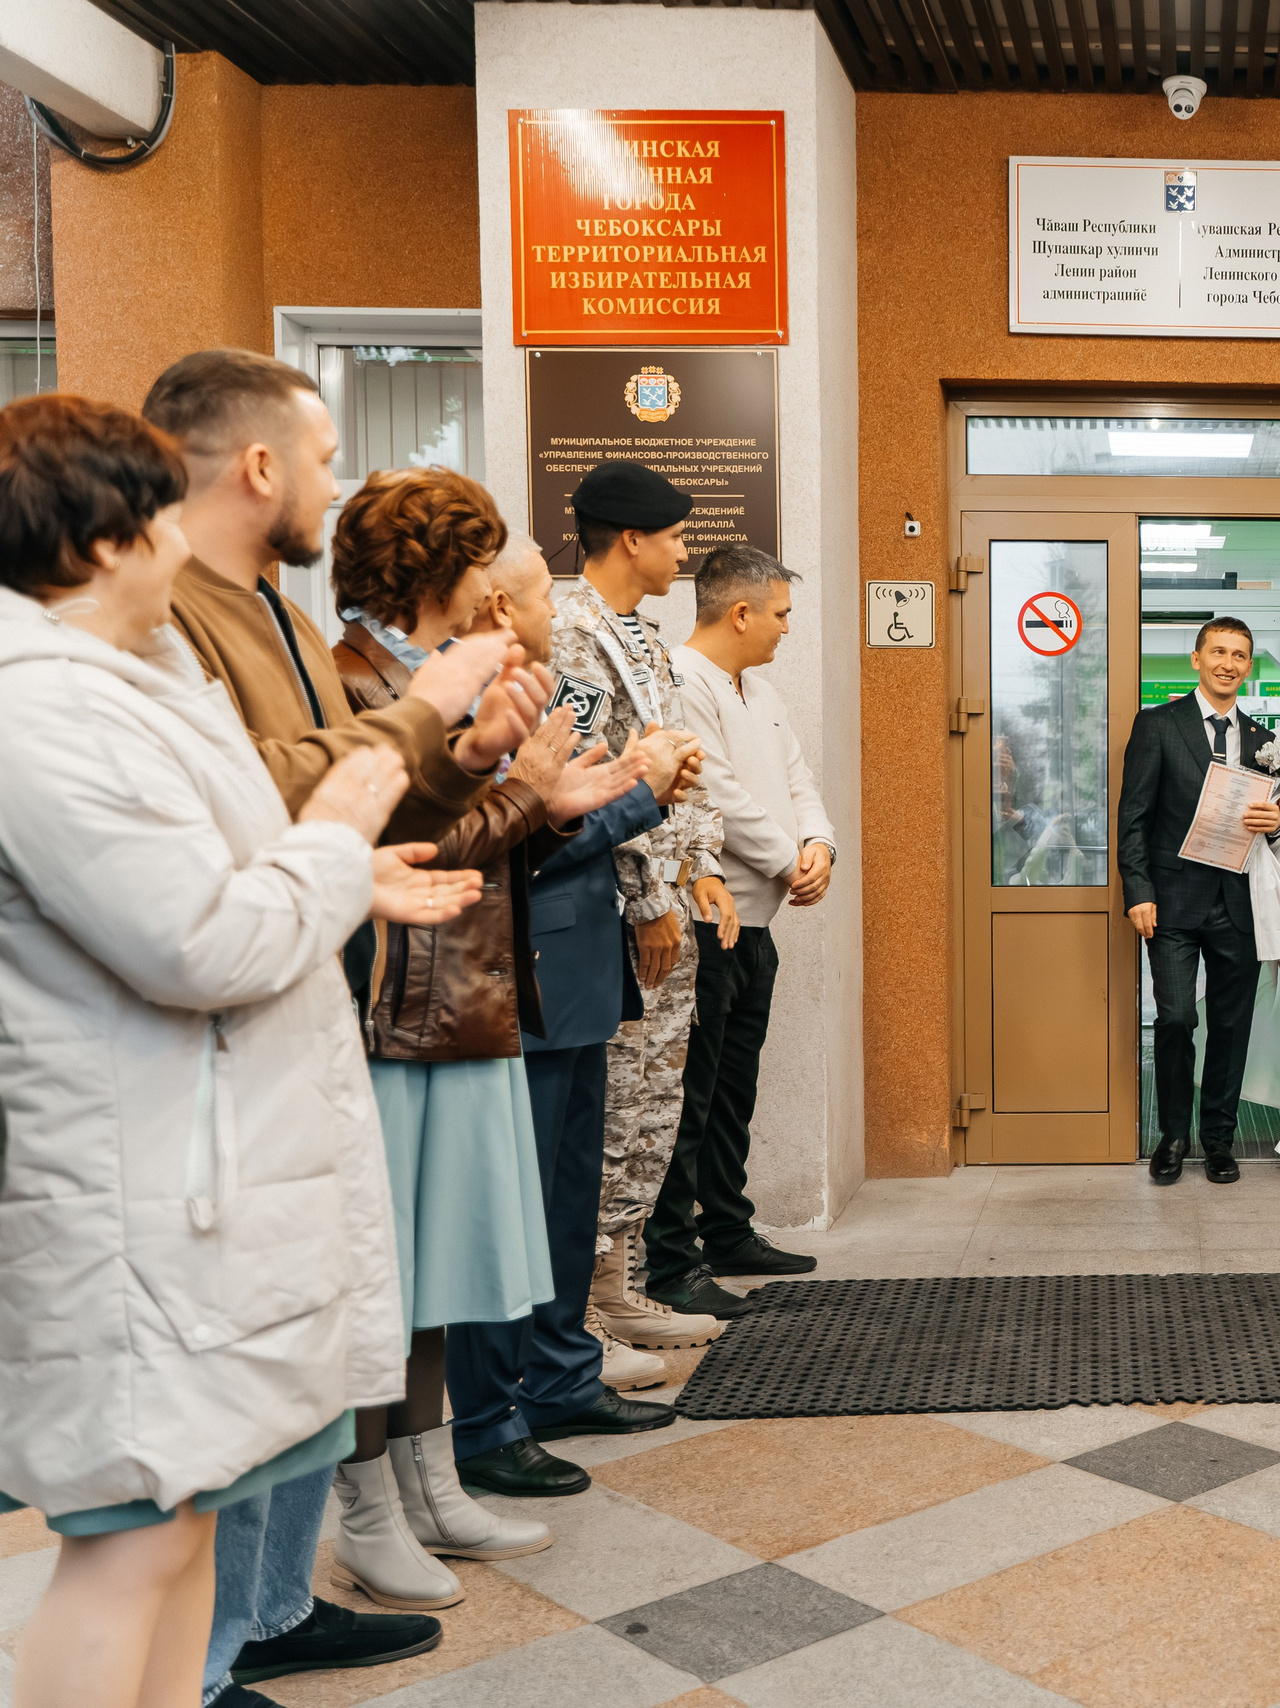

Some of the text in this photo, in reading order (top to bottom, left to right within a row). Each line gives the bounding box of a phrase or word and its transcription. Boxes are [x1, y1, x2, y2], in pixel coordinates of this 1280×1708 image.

[603, 193, 696, 213] ГОРОДА
[575, 219, 722, 237] ЧЕБОКСАРЫ
[1036, 217, 1156, 236] Чӑваш Республики
[531, 245, 767, 263] ТЕРРИТОРИАЛЬНАЯ
[1032, 240, 1159, 259] Шупашкар хулинчи
[550, 271, 751, 289] ИЗБИРАТЕЛЬНАЯ
[1054, 263, 1137, 281] Ленин район
[1203, 266, 1278, 281] Ленинского
[582, 297, 721, 315] КОМИССИЯ
[1207, 292, 1248, 306] города
[550, 437, 757, 447] МУНИЦИПАЛЬНОЕ БЮДЖЕТНОЕ УЧРЕЖДЕНИЕ
[539, 451, 769, 460] «УПРАВЛЕНИЕ ФИНАНСОВО-ПРОИЗВОДСТВЕННОГО
[545, 463, 763, 474] ОБЕСПЕЧЕ ИПАЛЬНЫХ УЧРЕЖДЕНИЙ
[668, 478, 729, 486] ЧЕБОКСАРЫ»
[697, 534, 748, 542] ФИНАНСПА
